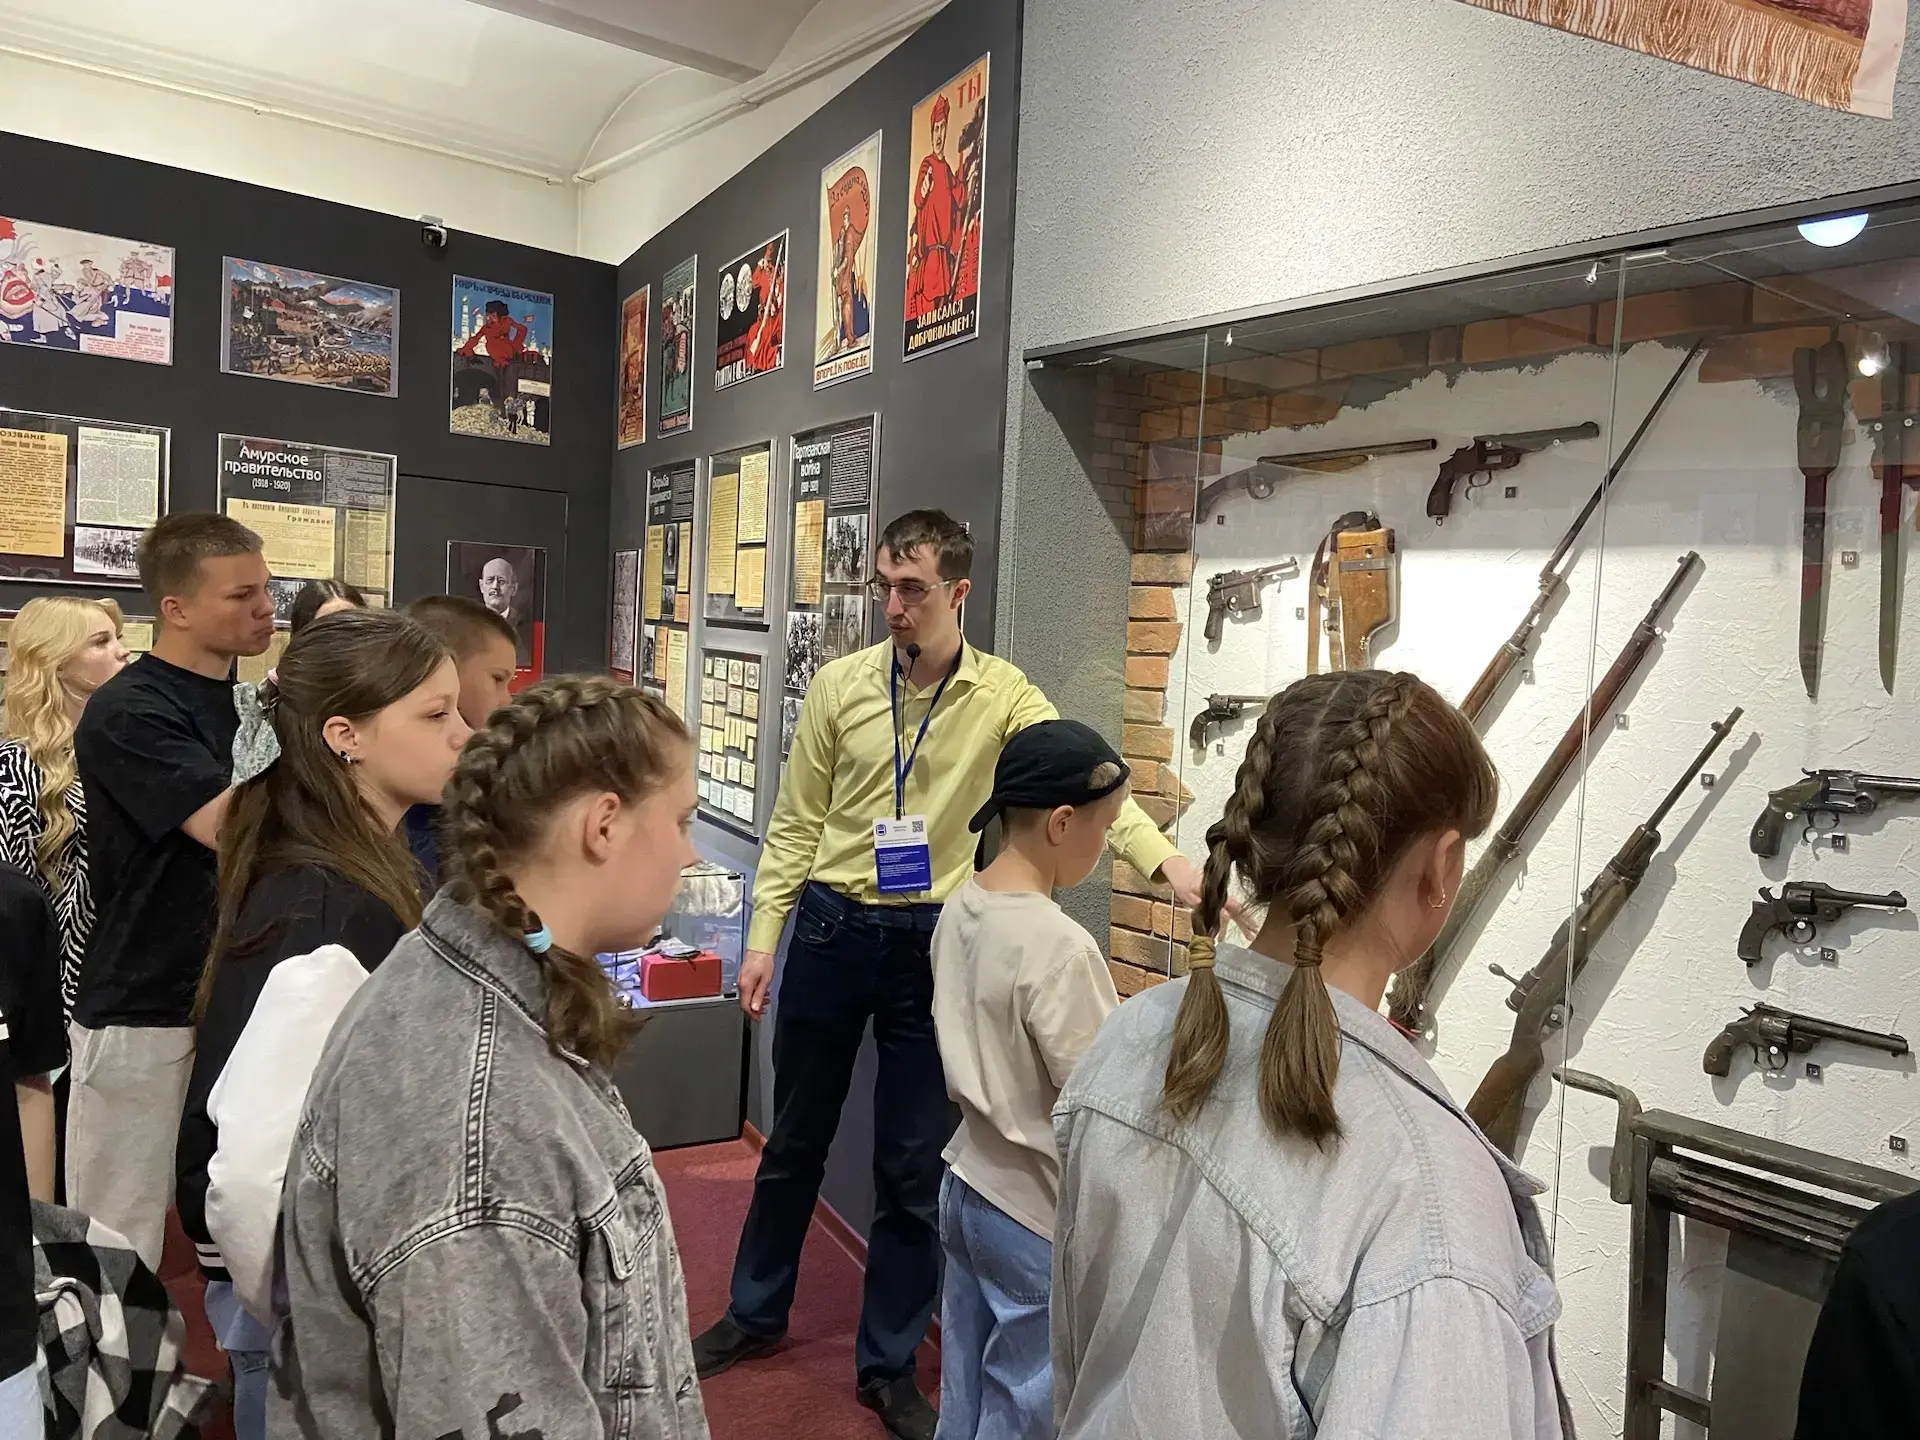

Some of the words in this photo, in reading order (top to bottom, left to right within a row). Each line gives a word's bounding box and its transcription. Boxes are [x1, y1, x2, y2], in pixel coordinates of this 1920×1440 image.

[957, 72, 981, 108] ТЫ
[916, 298, 963, 329] ЗАПИСАЛСЯ
[907, 309, 975, 352] ДОБРОВОЛЬЦЕМ?
[843, 353, 867, 371] ПОБЕДЕ
[240, 445, 309, 466] Амурское
[224, 460, 322, 481] правительство
[800, 459, 821, 477] война
[252, 478, 269, 490] (1918
[274, 481, 291, 492] 1920)
[1844, 554, 1853, 562] 10
[1823, 951, 1833, 960] 12
[1809, 1067, 1818, 1075] 13
[1893, 1140, 1902, 1149] 15
